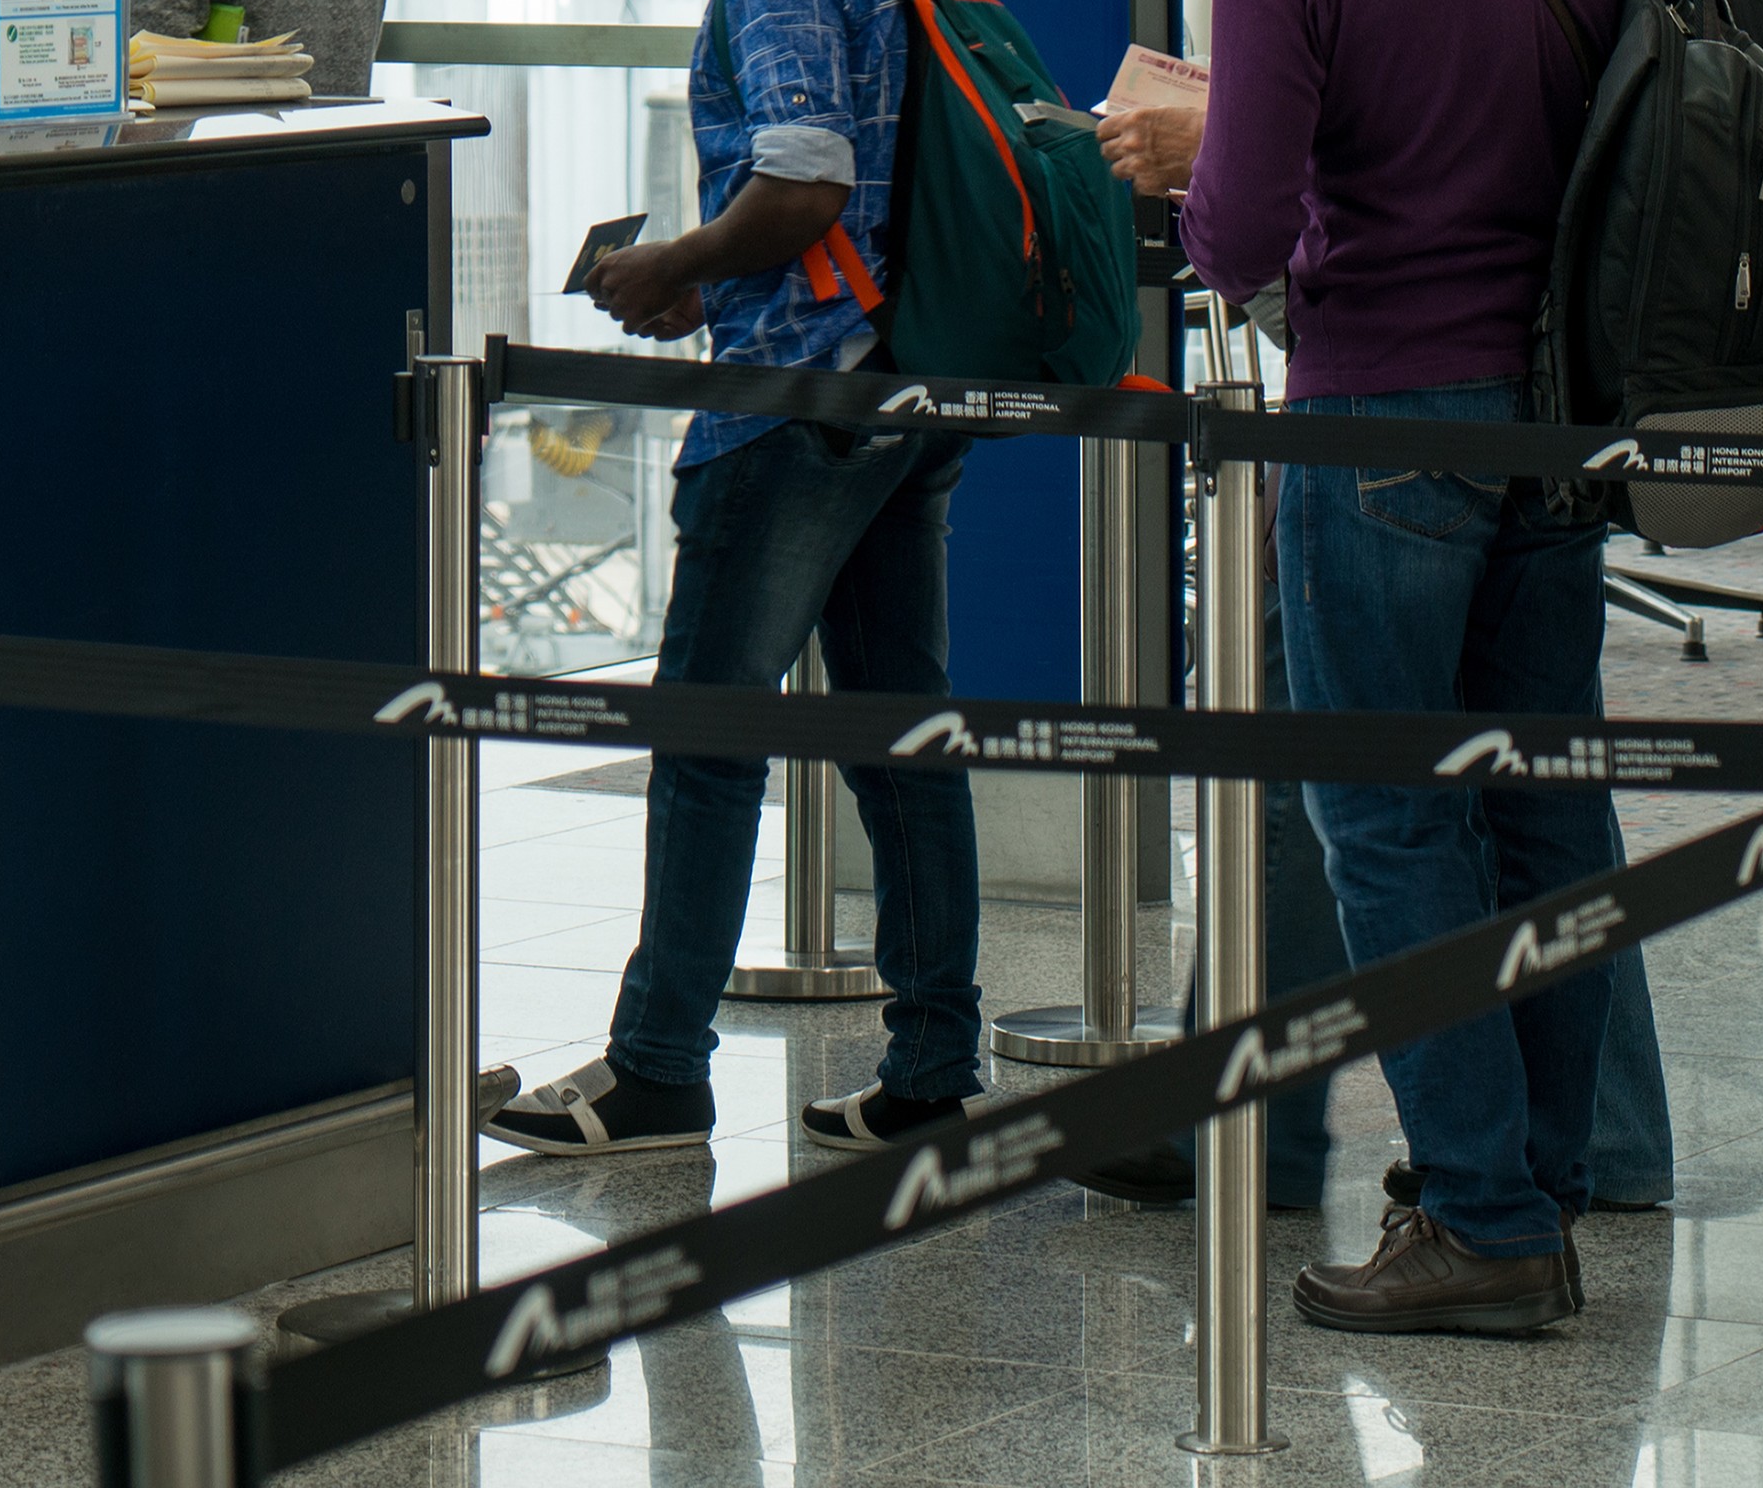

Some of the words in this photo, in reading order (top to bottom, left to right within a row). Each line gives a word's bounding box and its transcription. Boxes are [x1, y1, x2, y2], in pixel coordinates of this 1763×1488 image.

[995, 392, 1019, 400] HONG
[1021, 393, 1045, 401] KONG
[995, 400, 1060, 412] INTERNATIONAL
[995, 411, 1031, 419] AIRPORT
[1680, 445, 1705, 460] 香港
[1712, 446, 1739, 456] HONG
[1653, 458, 1705, 474] 國際機場
[1712, 467, 1752, 476] AIRPORT
